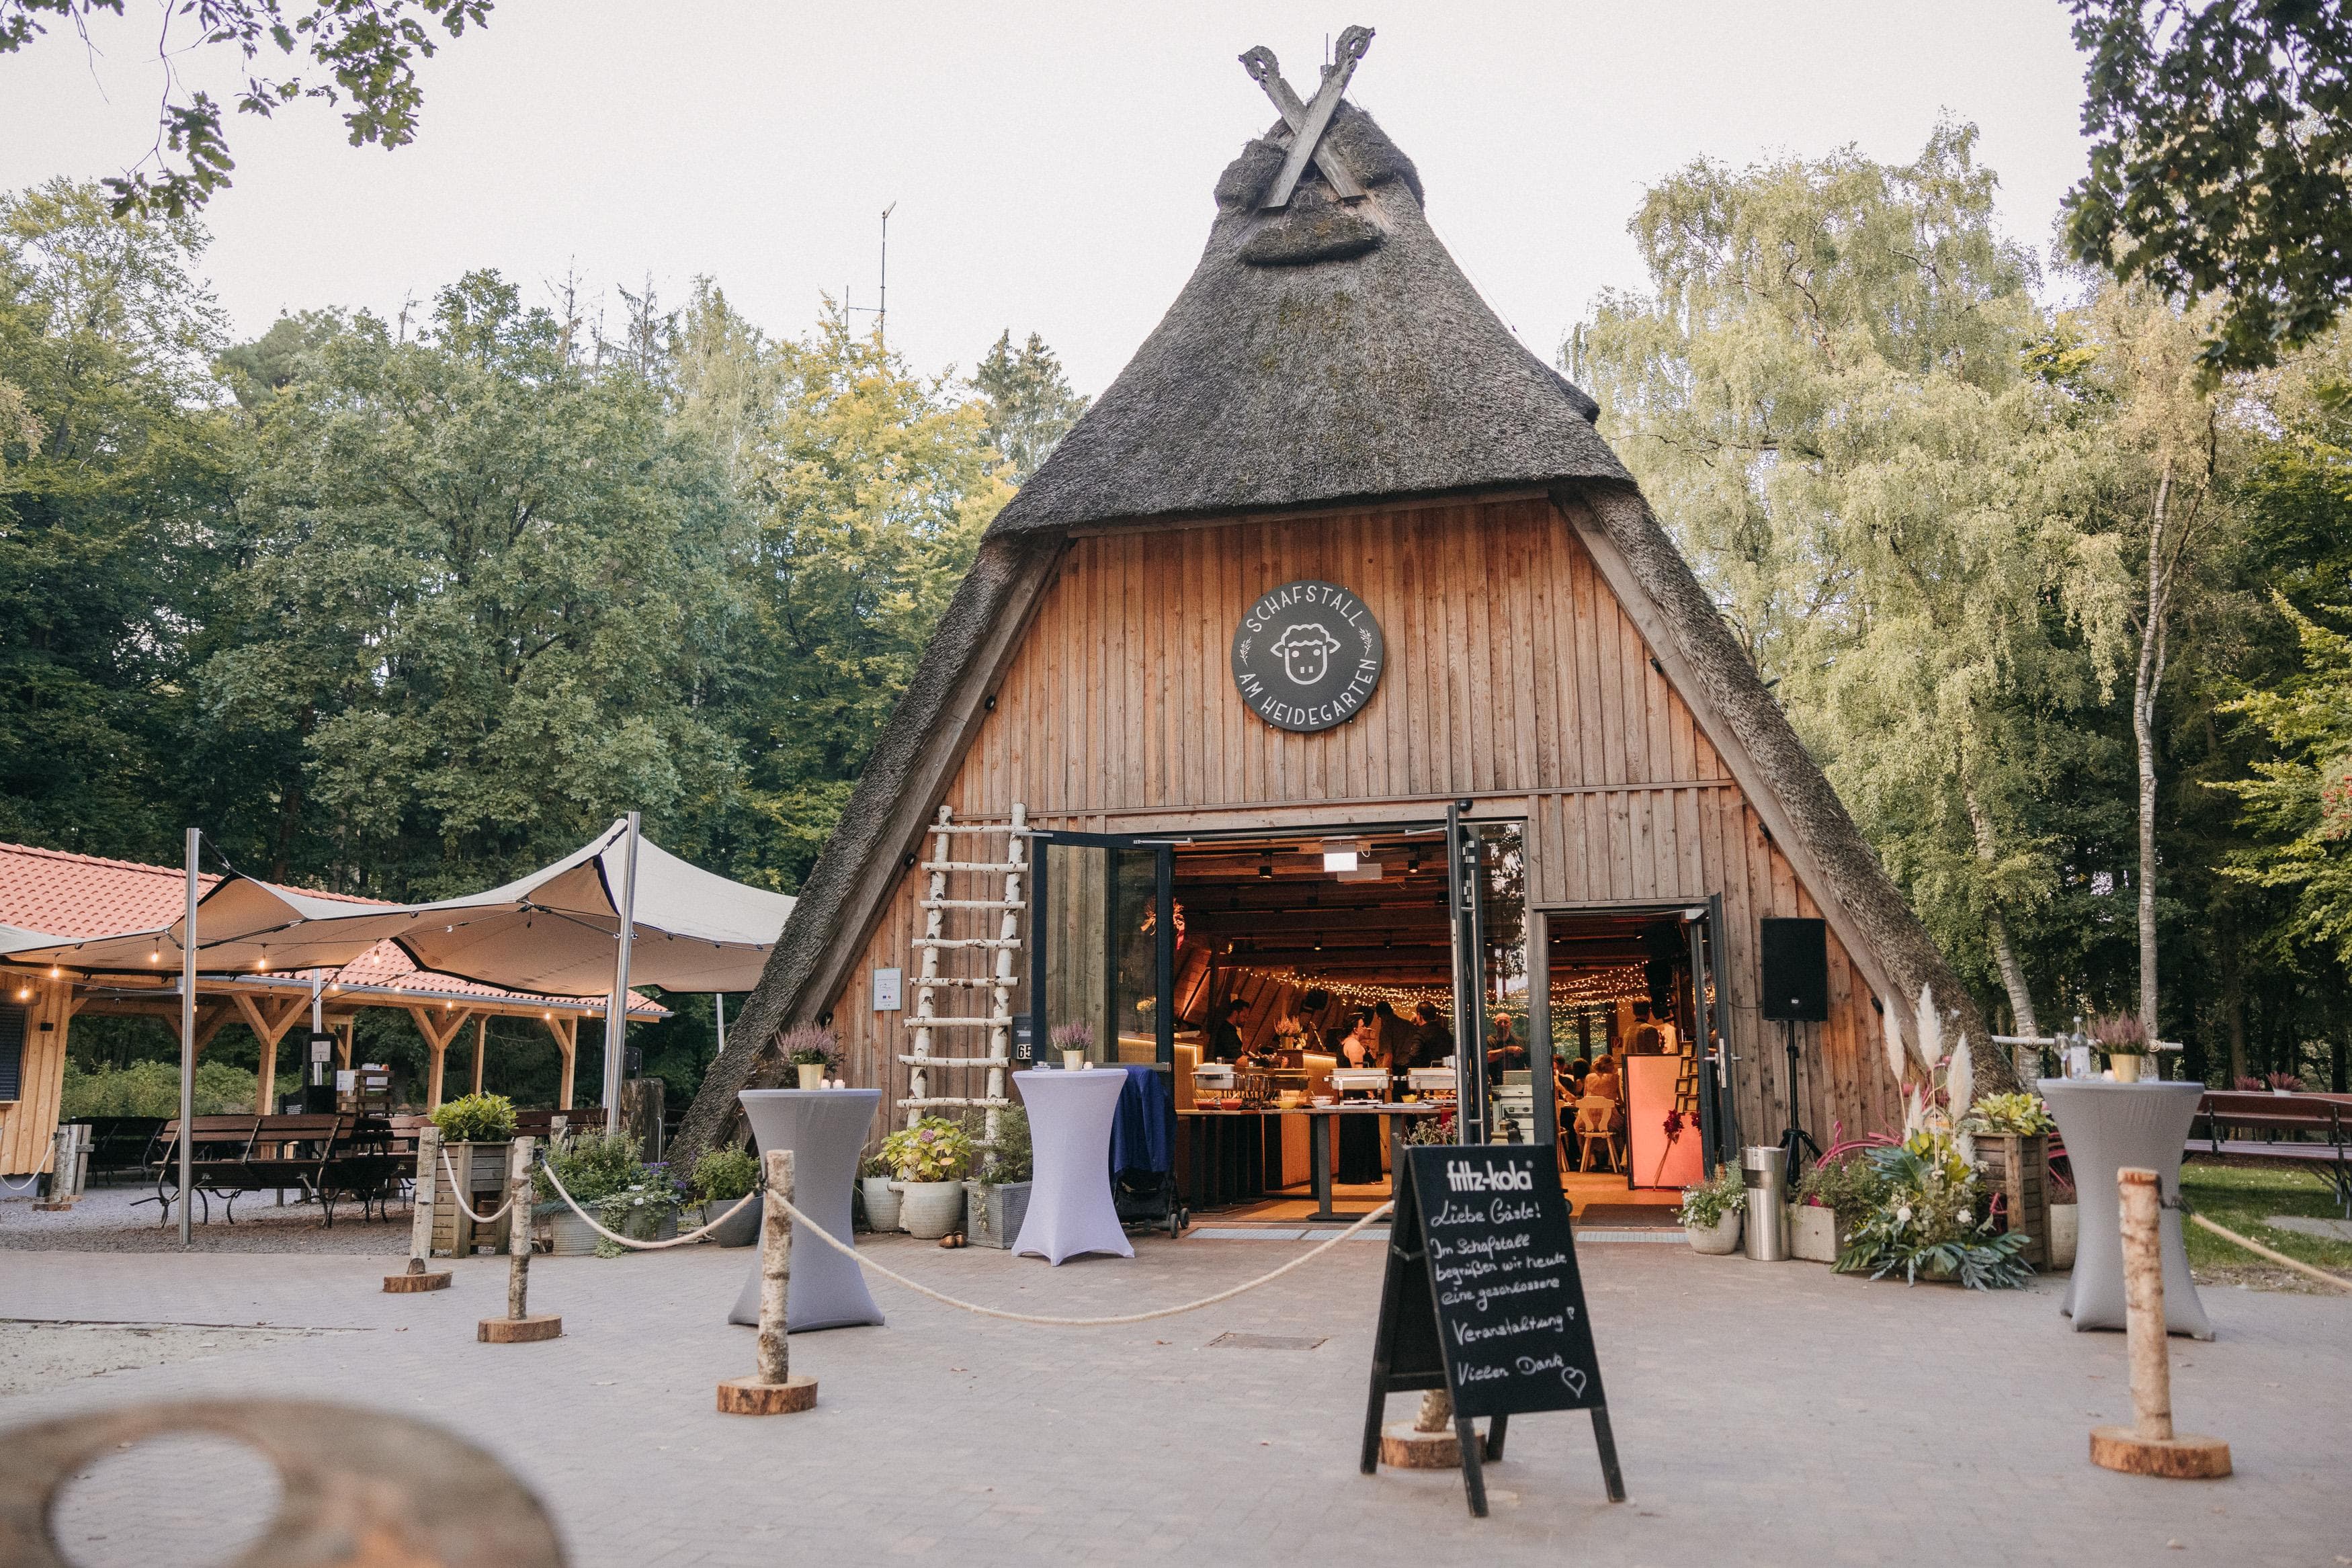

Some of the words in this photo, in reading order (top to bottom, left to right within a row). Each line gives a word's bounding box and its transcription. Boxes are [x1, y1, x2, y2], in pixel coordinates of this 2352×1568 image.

[1246, 584, 1363, 633] SCHAFSTALL
[1238, 673, 1264, 699] AM
[1260, 658, 1377, 726] HEIDEGARTEN
[1018, 1045, 1032, 1058] 65
[1430, 1199, 1486, 1227] Liebe
[1489, 1197, 1542, 1225] Gäste!
[1429, 1237, 1454, 1259] Im
[1456, 1233, 1530, 1260] Schafstall
[1435, 1260, 1499, 1285] begrüßen
[1501, 1256, 1523, 1272] wir
[1440, 1287, 1476, 1305] eine
[1476, 1277, 1560, 1312] geschlossene
[1457, 1361, 1510, 1387] Vielen
[1515, 1352, 1565, 1375] Dank
